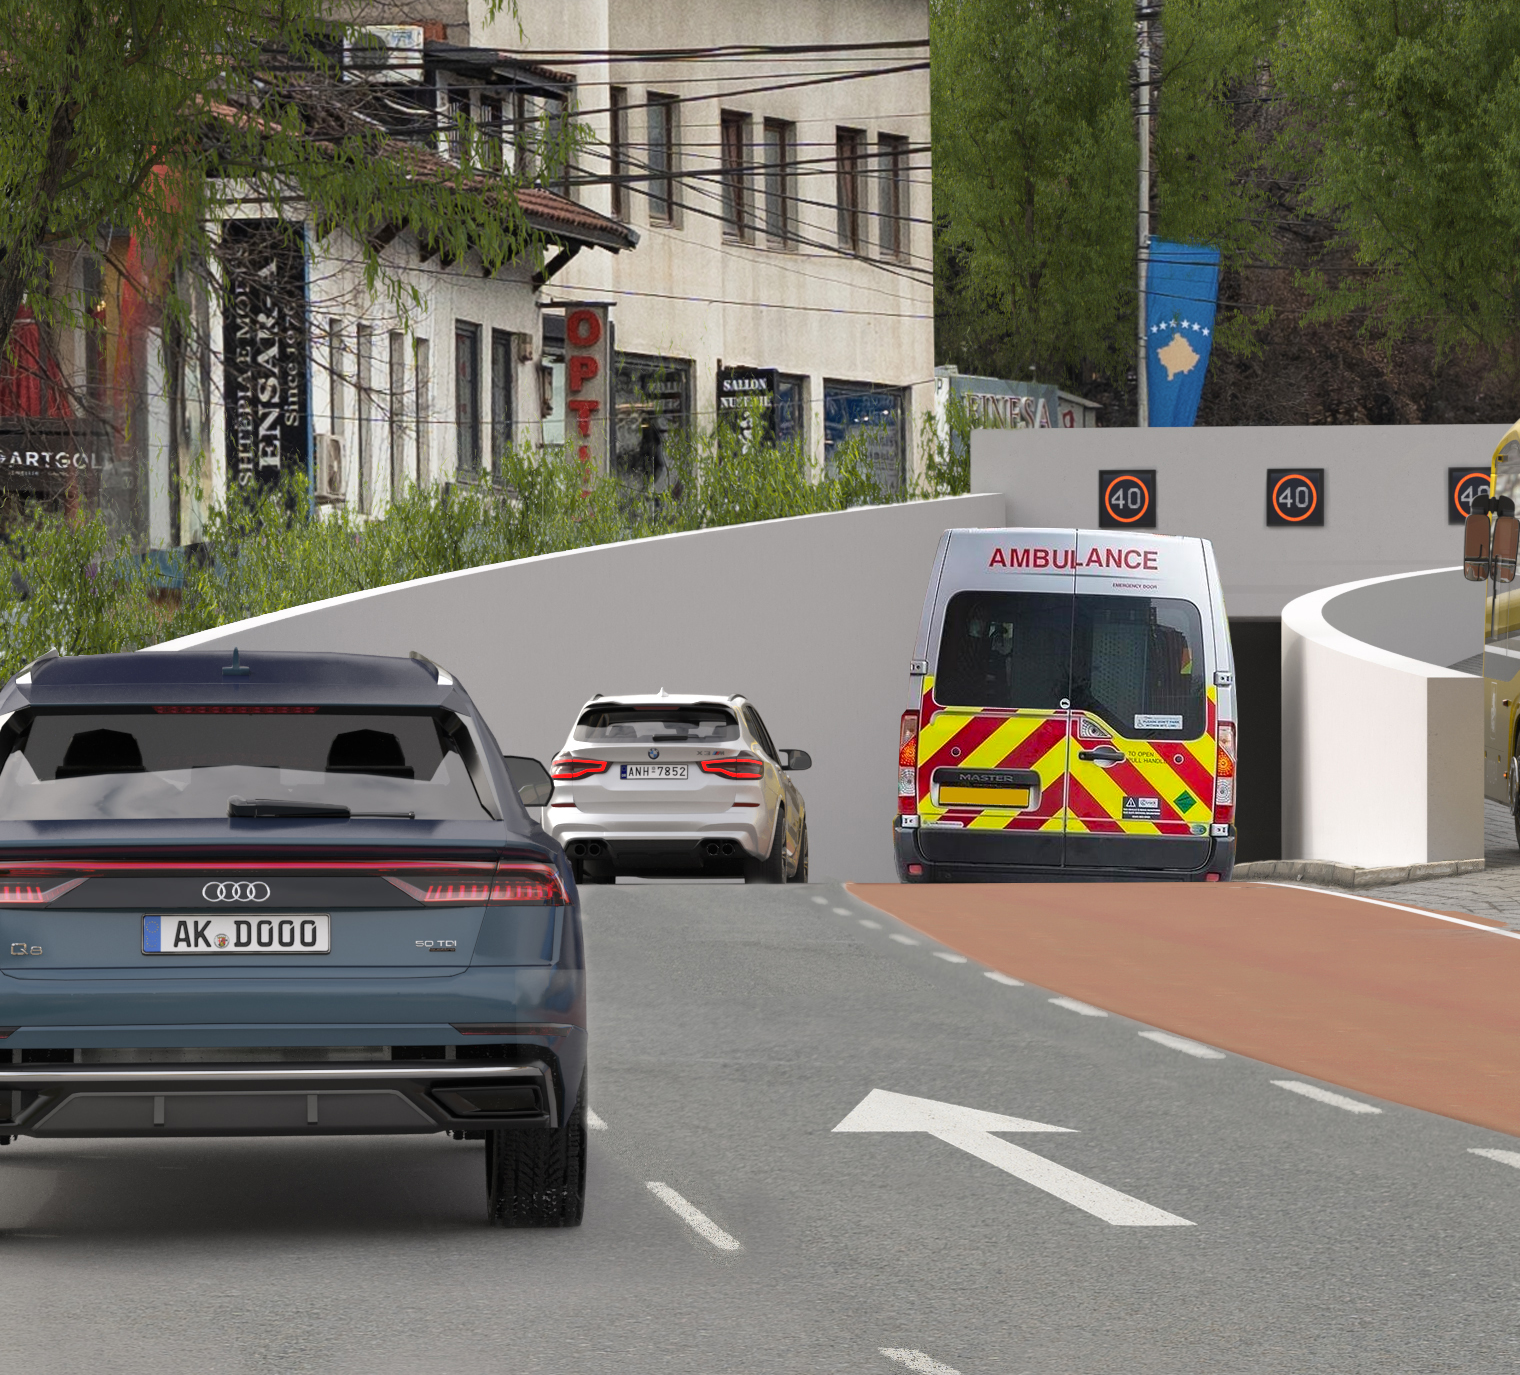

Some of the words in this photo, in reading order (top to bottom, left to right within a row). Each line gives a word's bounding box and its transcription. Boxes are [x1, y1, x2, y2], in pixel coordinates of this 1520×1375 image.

[284, 361, 300, 426] Since
[723, 378, 767, 392] SALLON
[1111, 487, 1141, 509] 40
[1278, 486, 1309, 508] 40
[989, 548, 1158, 571] AMBULANCE
[628, 766, 650, 777] ANH
[657, 766, 686, 777] 7852
[959, 773, 1014, 782] MASTER
[173, 920, 212, 948] AK
[10, 942, 43, 956] Q8
